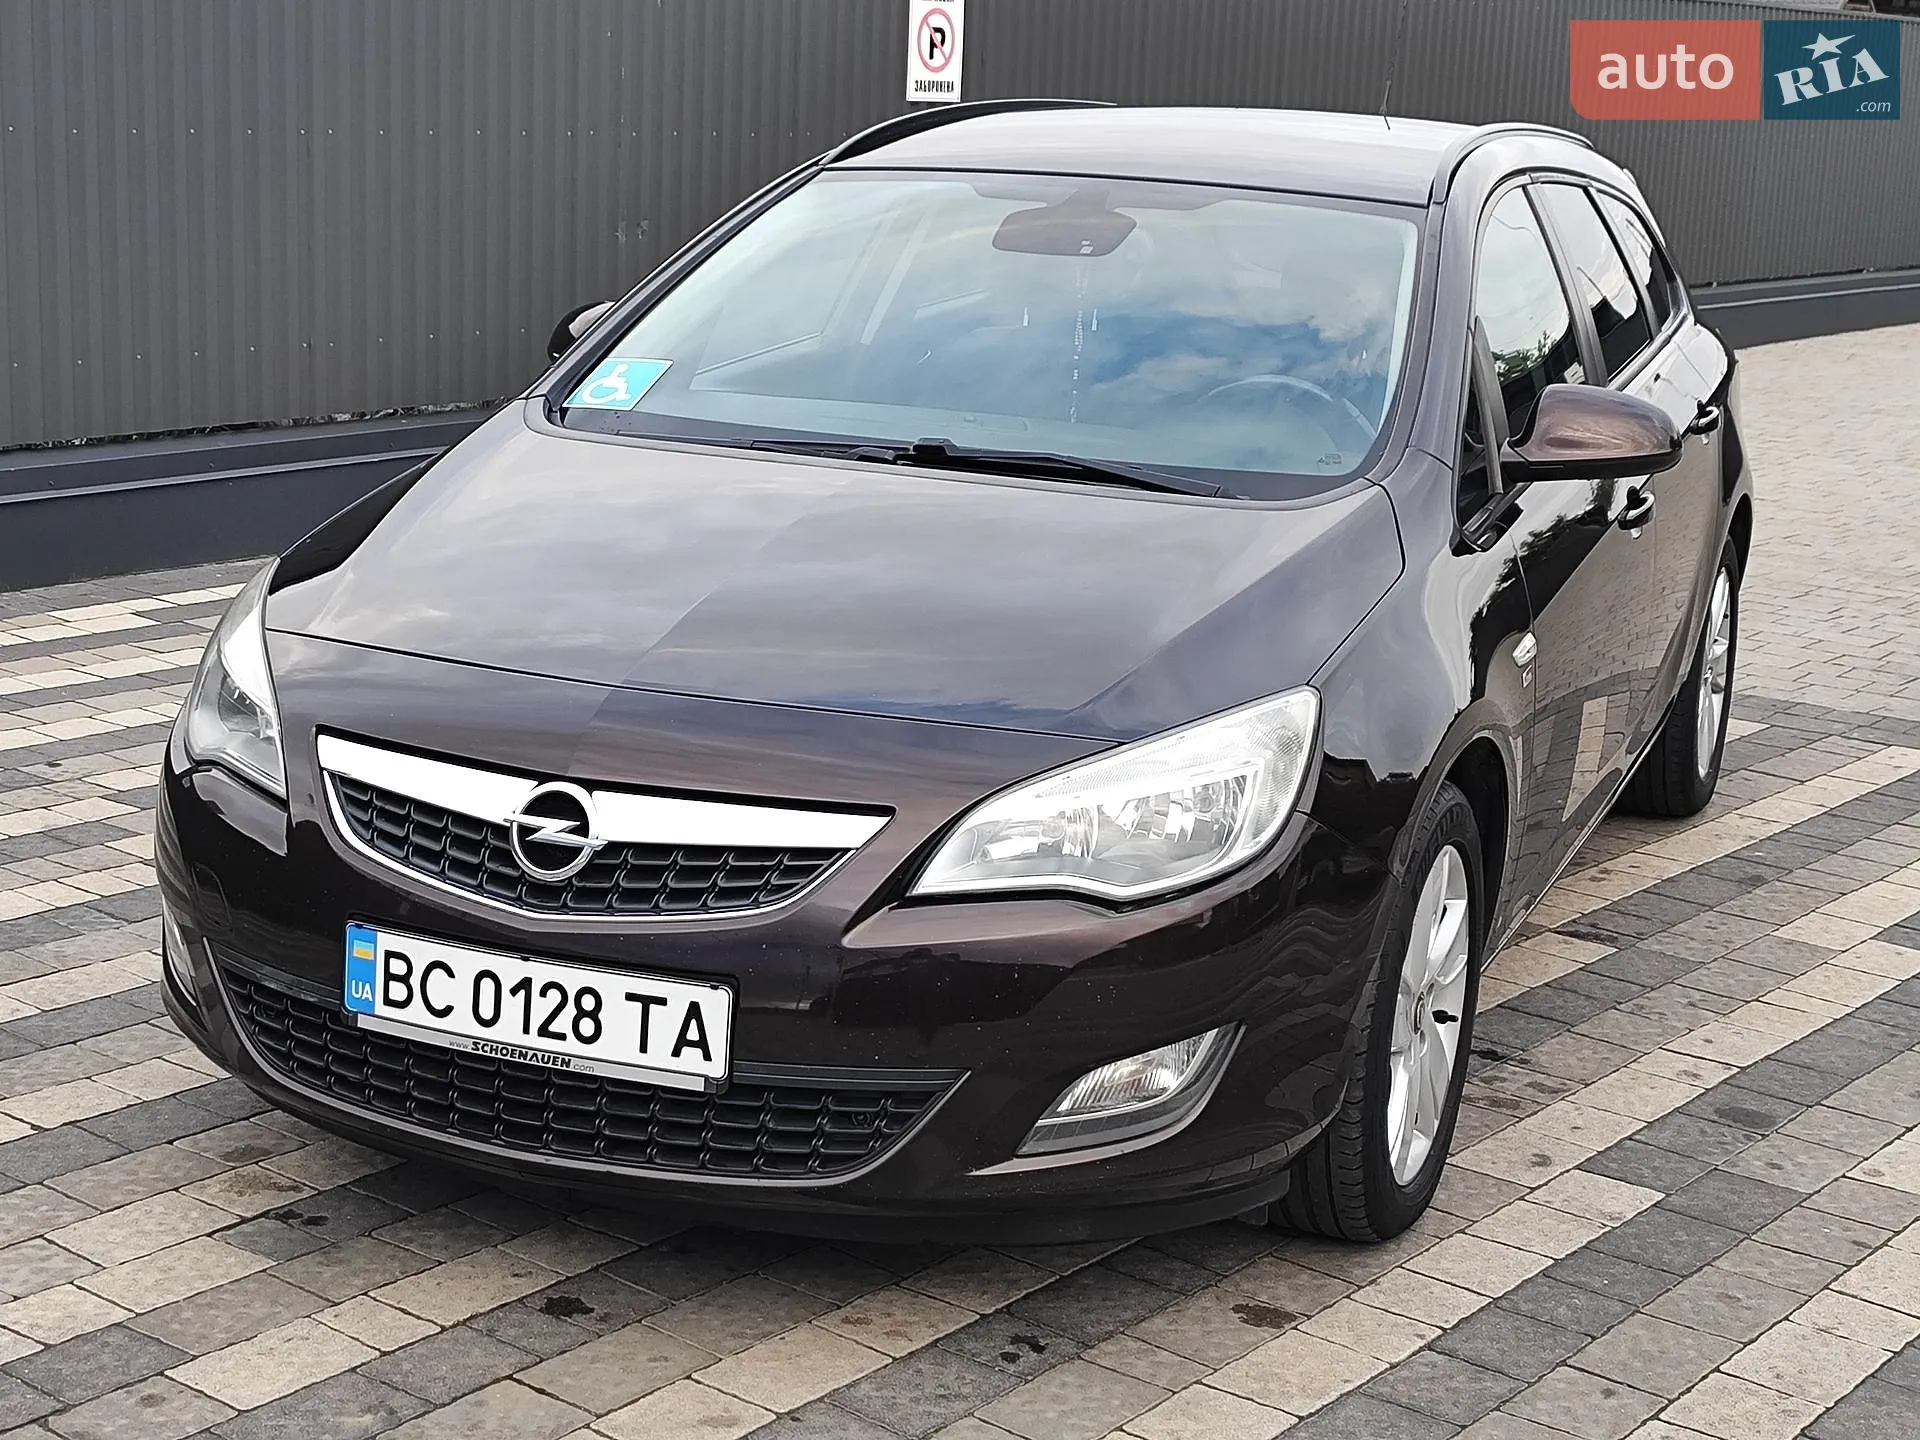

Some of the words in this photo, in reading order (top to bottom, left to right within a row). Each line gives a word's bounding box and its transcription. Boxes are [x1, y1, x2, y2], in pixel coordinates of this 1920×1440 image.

[351, 979, 374, 1002] UA
[383, 948, 456, 1019] BC
[471, 968, 603, 1045] 0128
[624, 990, 713, 1062] TA
